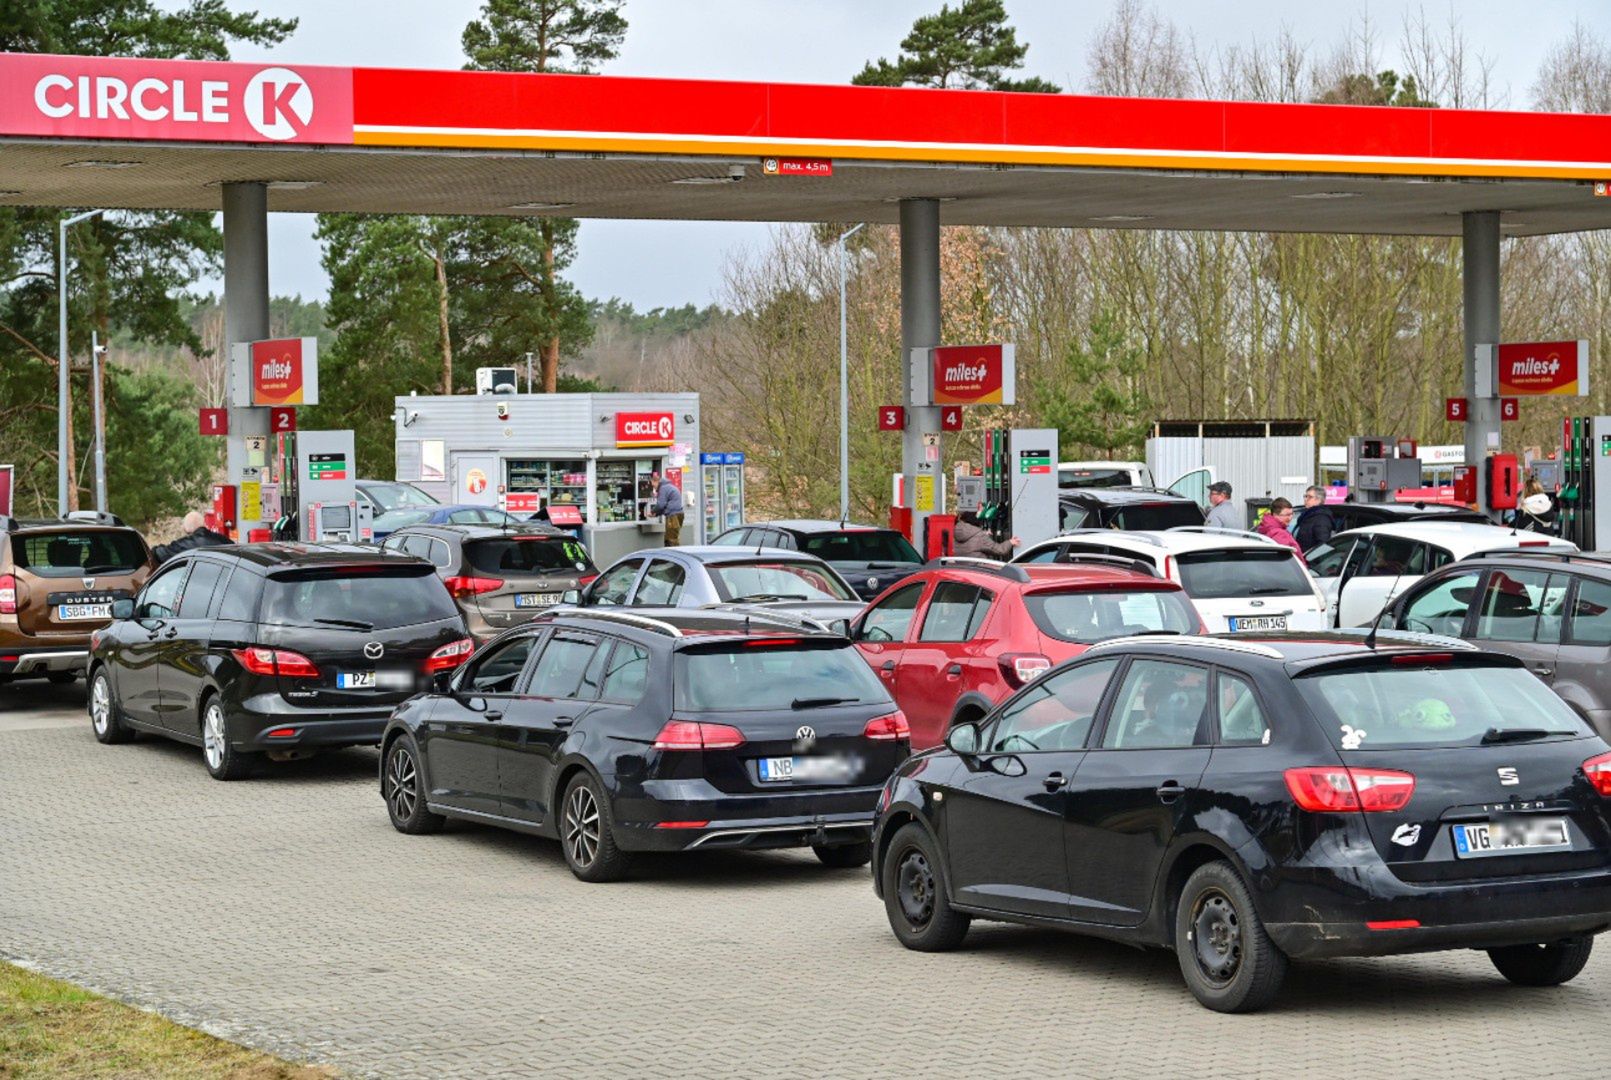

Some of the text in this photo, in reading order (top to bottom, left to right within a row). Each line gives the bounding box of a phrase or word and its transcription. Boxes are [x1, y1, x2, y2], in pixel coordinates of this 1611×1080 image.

[34, 67, 314, 141] CIRCLE K
[783, 162, 803, 171] max.
[1451, 403, 1460, 416] 5
[1504, 403, 1514, 416] 6
[209, 414, 217, 429] 1
[278, 413, 289, 428] 2
[886, 411, 896, 425] 3
[946, 411, 957, 425] 4
[624, 416, 672, 438] CIRCLE K
[253, 441, 260, 449] 2
[929, 437, 936, 445] 2
[66, 596, 113, 604] DUSTER
[66, 607, 86, 617] SBG
[1236, 618, 1285, 629] UEM RH 145
[352, 673, 368, 685] PZ
[773, 760, 792, 775] NB
[1467, 828, 1490, 850] VG
